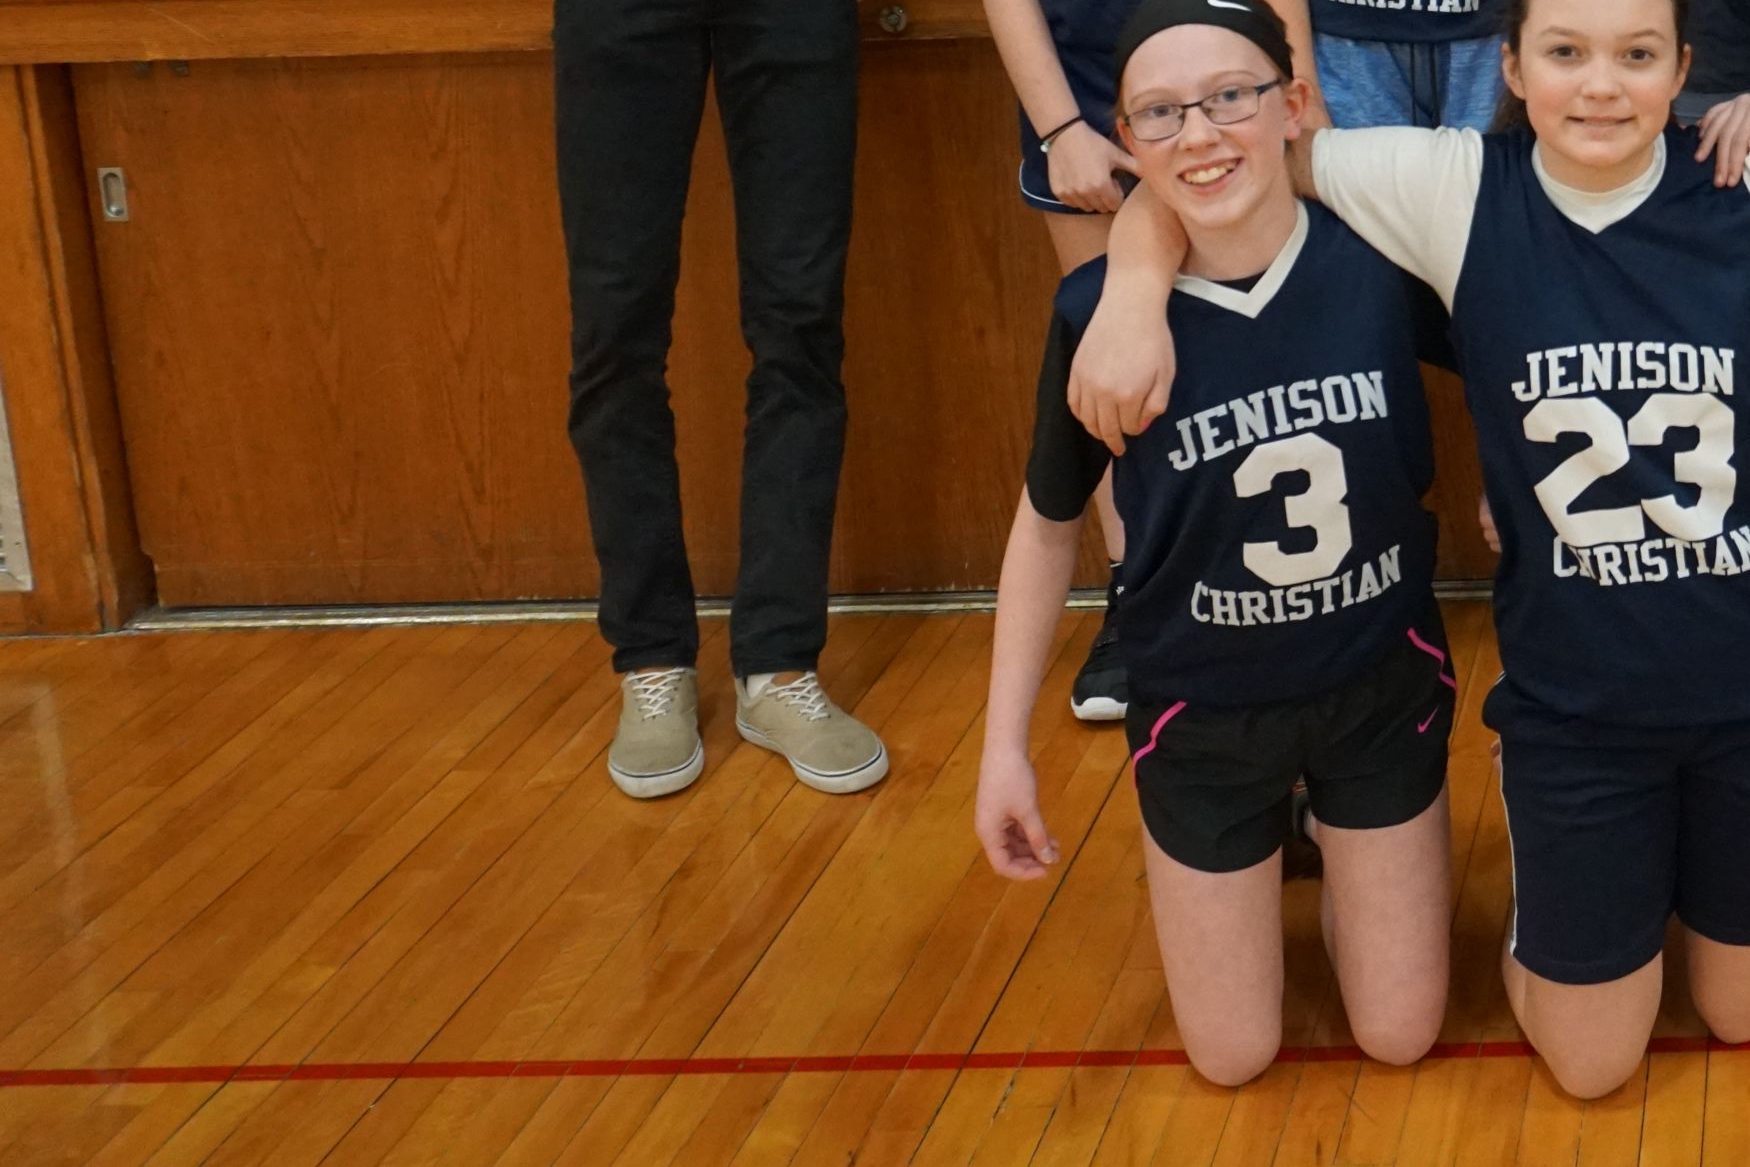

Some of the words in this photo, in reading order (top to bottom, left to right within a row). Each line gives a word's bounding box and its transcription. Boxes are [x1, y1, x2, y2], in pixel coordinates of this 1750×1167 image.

[1168, 370, 1388, 471] JENISON
[1511, 341, 1735, 402] JENISON
[1233, 432, 1352, 586] 3
[1522, 392, 1737, 548] 23
[1191, 544, 1401, 626] CHRISTIAN
